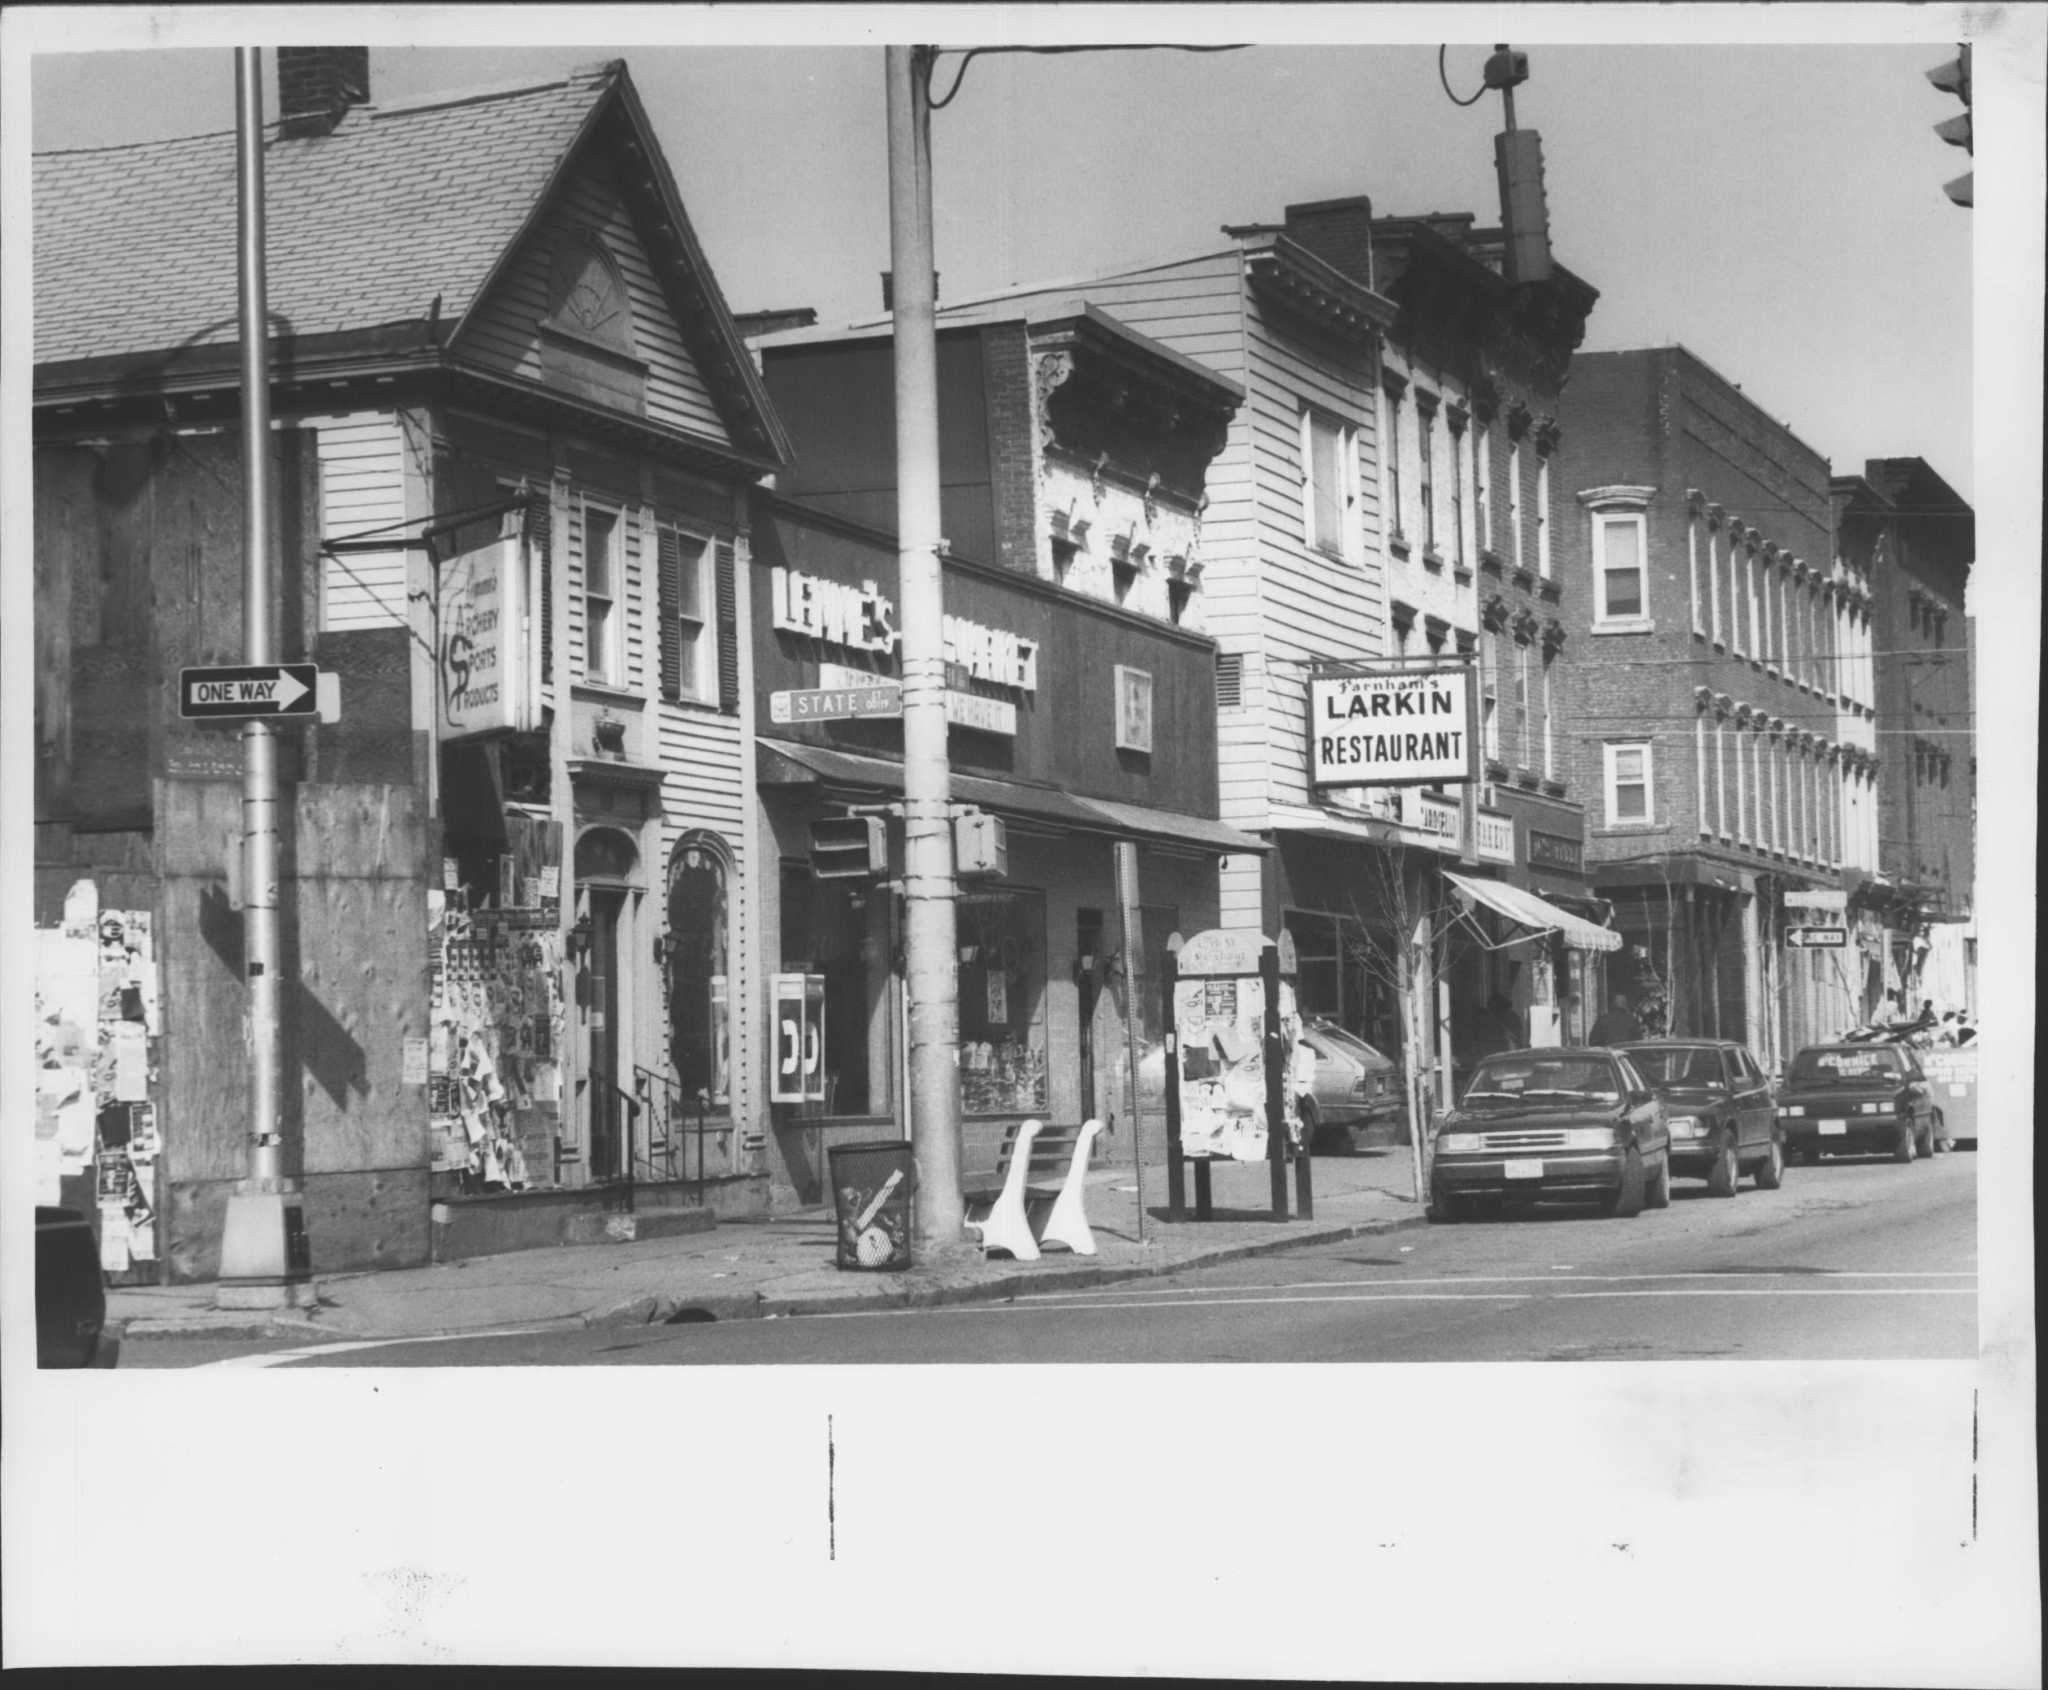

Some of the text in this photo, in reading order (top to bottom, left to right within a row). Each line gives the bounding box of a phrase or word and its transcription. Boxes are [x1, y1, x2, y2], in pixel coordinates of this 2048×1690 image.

[198, 682, 276, 701] ONE WAY
[798, 694, 857, 714] STATE
[1327, 691, 1452, 719] LARKIN
[1321, 732, 1462, 764] RESTAURANT
